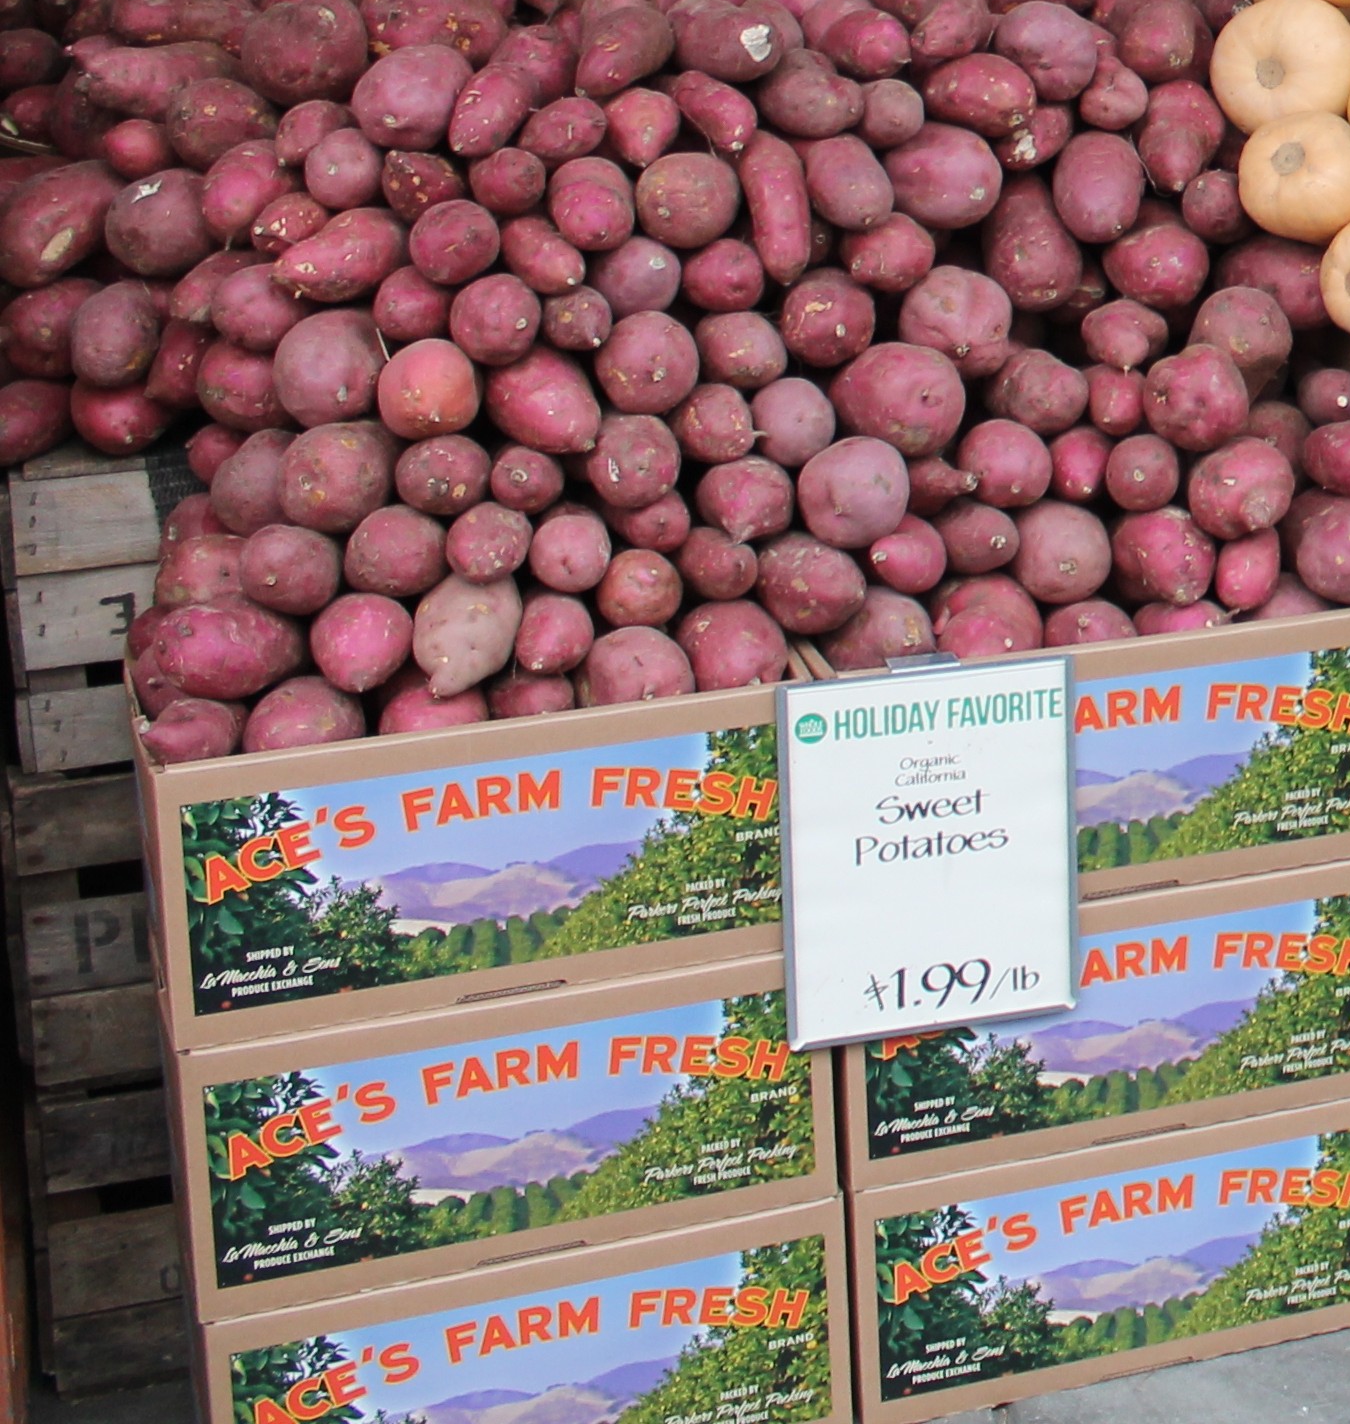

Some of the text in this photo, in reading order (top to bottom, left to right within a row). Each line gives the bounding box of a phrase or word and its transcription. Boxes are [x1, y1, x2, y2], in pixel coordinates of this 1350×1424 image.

[834, 687, 1063, 741] HOLIDAY FAVORITE
[1074, 684, 1181, 734] ARM
[895, 768, 966, 787] California
[899, 753, 961, 773] Organic
[875, 788, 991, 825] Sweet
[205, 768, 778, 902] ACE'S FARM FRESH
[855, 826, 1010, 866] Potatoes
[1080, 935, 1188, 989] ARM
[227, 1036, 792, 1179] ACE'S FARM FRESH
[750, 1085, 797, 1103] BRAND
[701, 1137, 740, 1154] PACKED BY
[693, 1165, 751, 1185] FRESH PRODUCE
[268, 1217, 315, 1236] SHIPPED BY
[894, 1212, 1035, 1303] ACE'S
[1059, 1173, 1194, 1235] FARM
[253, 1245, 334, 1271] PRODUCE EXCHANGE
[444, 1295, 601, 1365] FARM
[629, 1287, 809, 1329] FRESH
